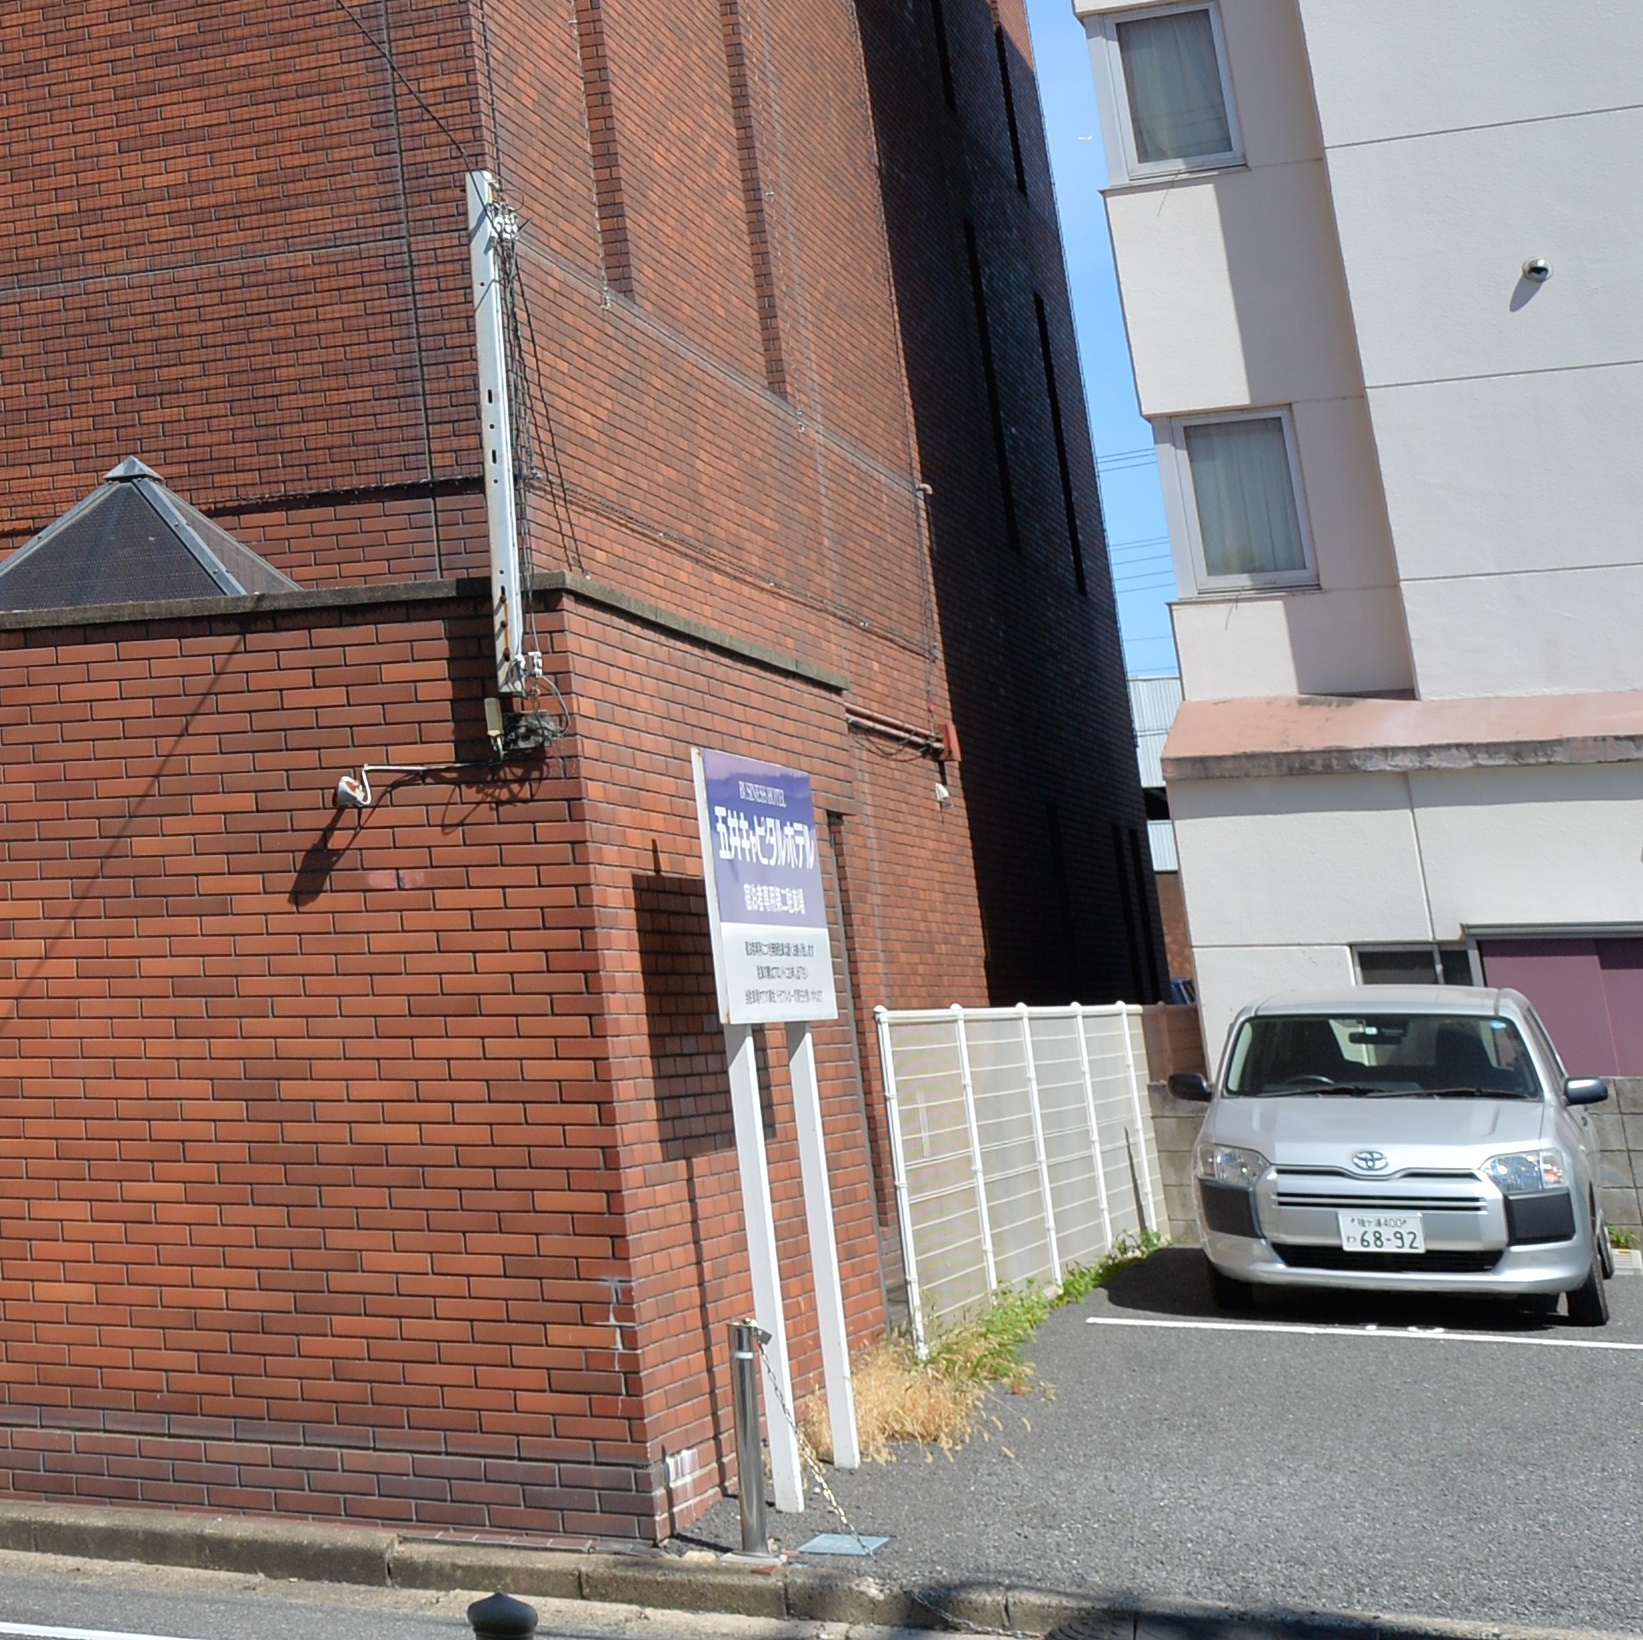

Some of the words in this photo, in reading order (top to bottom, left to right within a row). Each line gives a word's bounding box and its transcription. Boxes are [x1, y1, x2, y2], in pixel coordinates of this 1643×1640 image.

[715, 806, 814, 869] 五井キャピタルホテル
[1360, 1230, 1419, 1249] 68-92
